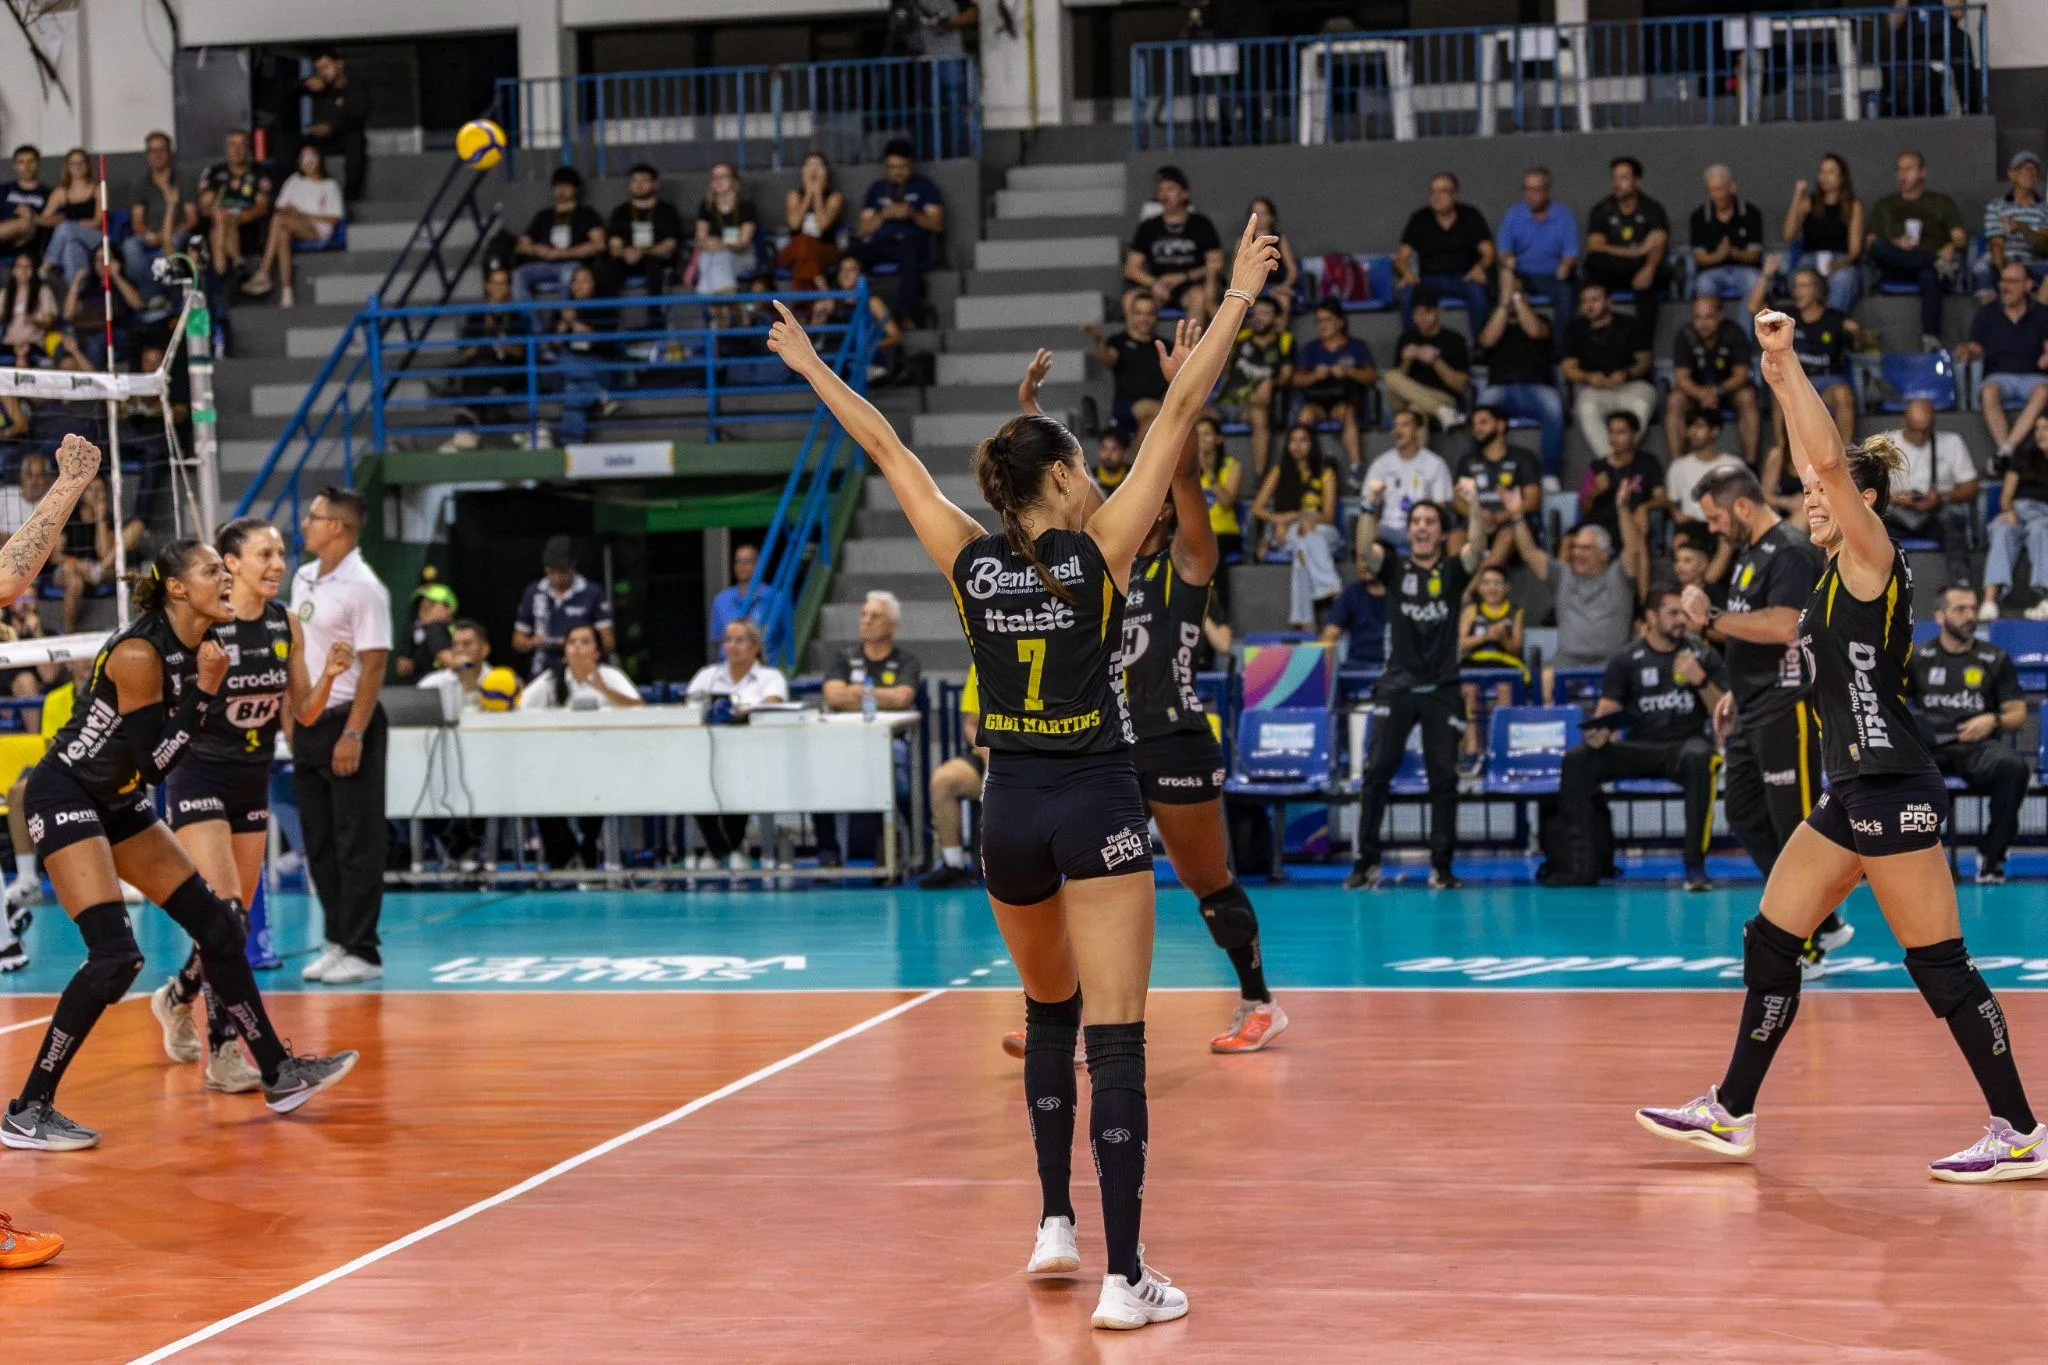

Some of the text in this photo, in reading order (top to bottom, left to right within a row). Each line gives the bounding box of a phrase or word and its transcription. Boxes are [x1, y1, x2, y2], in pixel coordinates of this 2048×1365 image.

[985, 598, 1075, 632] Italac
[1017, 638, 1046, 711] 7
[985, 710, 1101, 734] GABI MARTINS
[1900, 811, 1938, 824] PRO
[1900, 824, 1937, 834] PLAY
[1100, 833, 1142, 863] PRO
[1750, 995, 1786, 1042] Dentil
